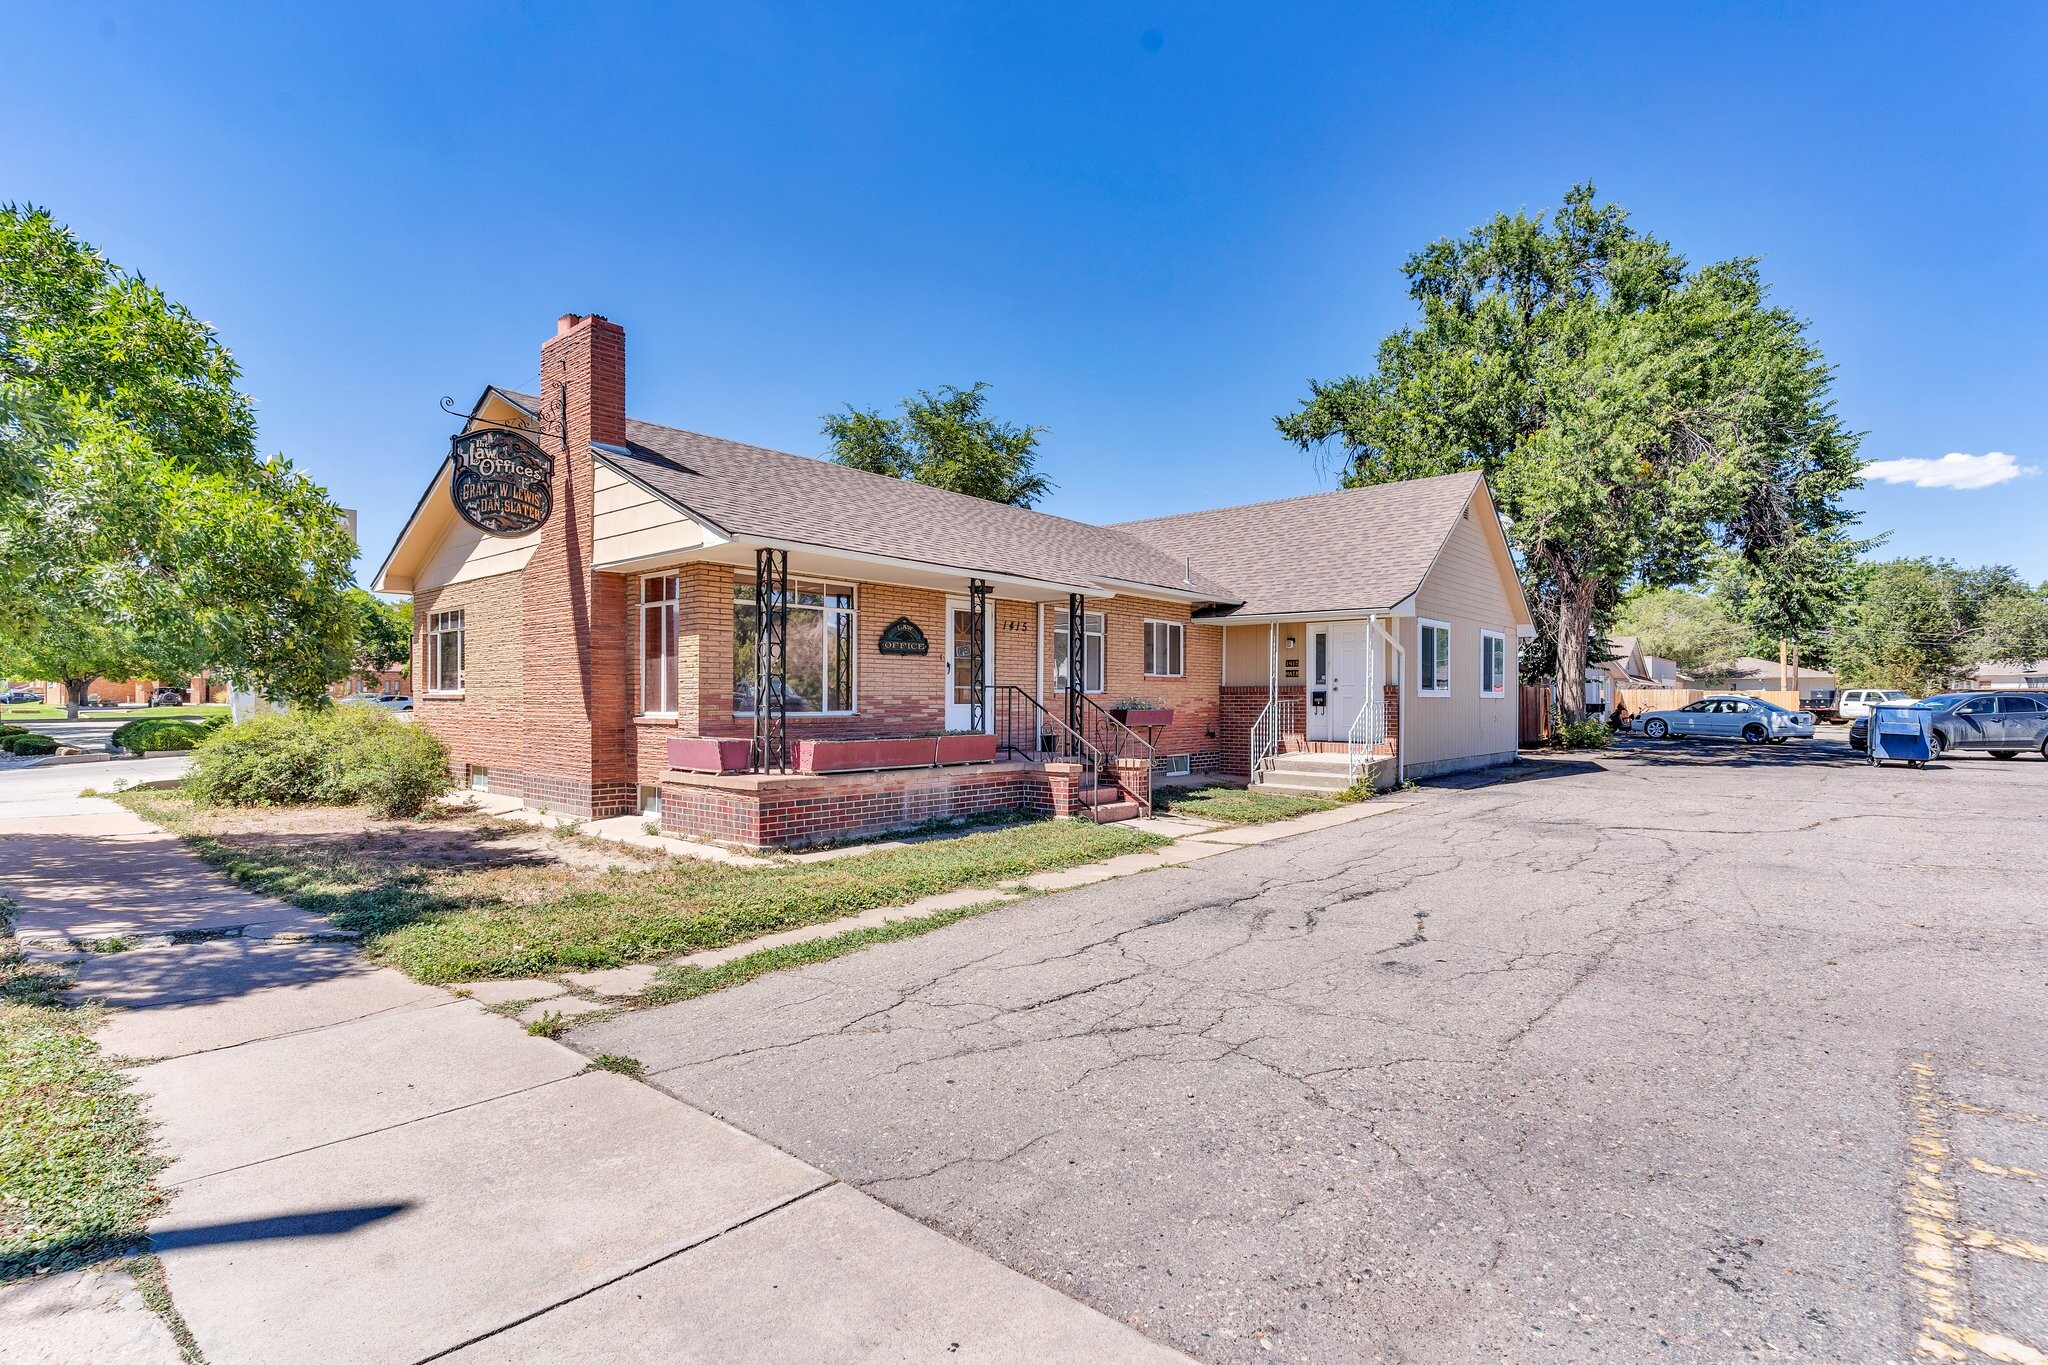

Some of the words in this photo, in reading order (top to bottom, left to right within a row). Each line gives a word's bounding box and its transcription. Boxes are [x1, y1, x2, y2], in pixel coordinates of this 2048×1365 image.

[470, 442, 497, 465] Law
[471, 438, 489, 448] The
[479, 459, 541, 480] Offices
[463, 483, 494, 500] GRANT
[513, 486, 541, 507] LEWIS
[481, 498, 500, 512] DAN
[504, 500, 540, 521] SLATER
[1003, 620, 1027, 632] 1415
[885, 641, 925, 650] OFFICE
